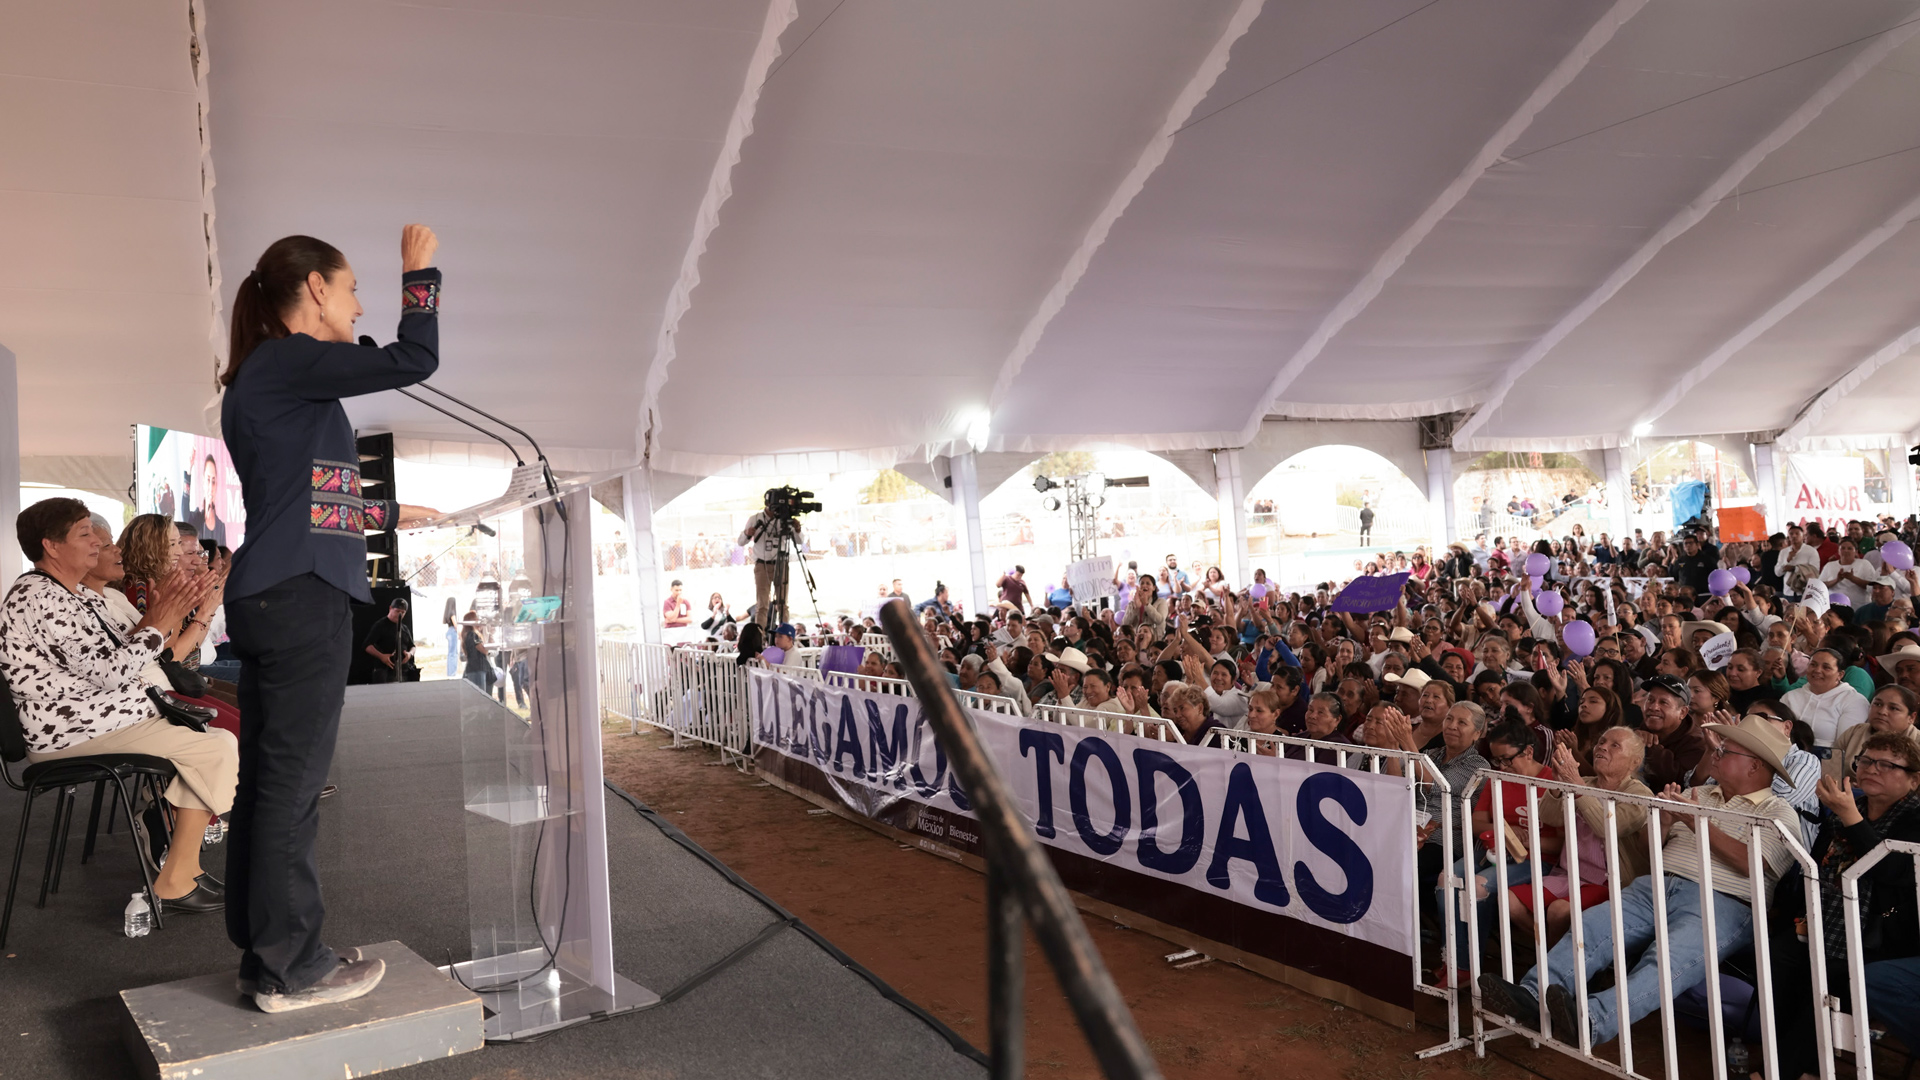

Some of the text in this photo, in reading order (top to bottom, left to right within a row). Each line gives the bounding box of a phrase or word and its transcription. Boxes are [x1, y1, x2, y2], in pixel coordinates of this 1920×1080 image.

[1794, 483, 1861, 511] AMOR
[918, 809, 944, 823] Gobierno de
[1019, 728, 1374, 924] TODAS
[917, 817, 944, 836] México
[949, 824, 979, 844] Bienestar
